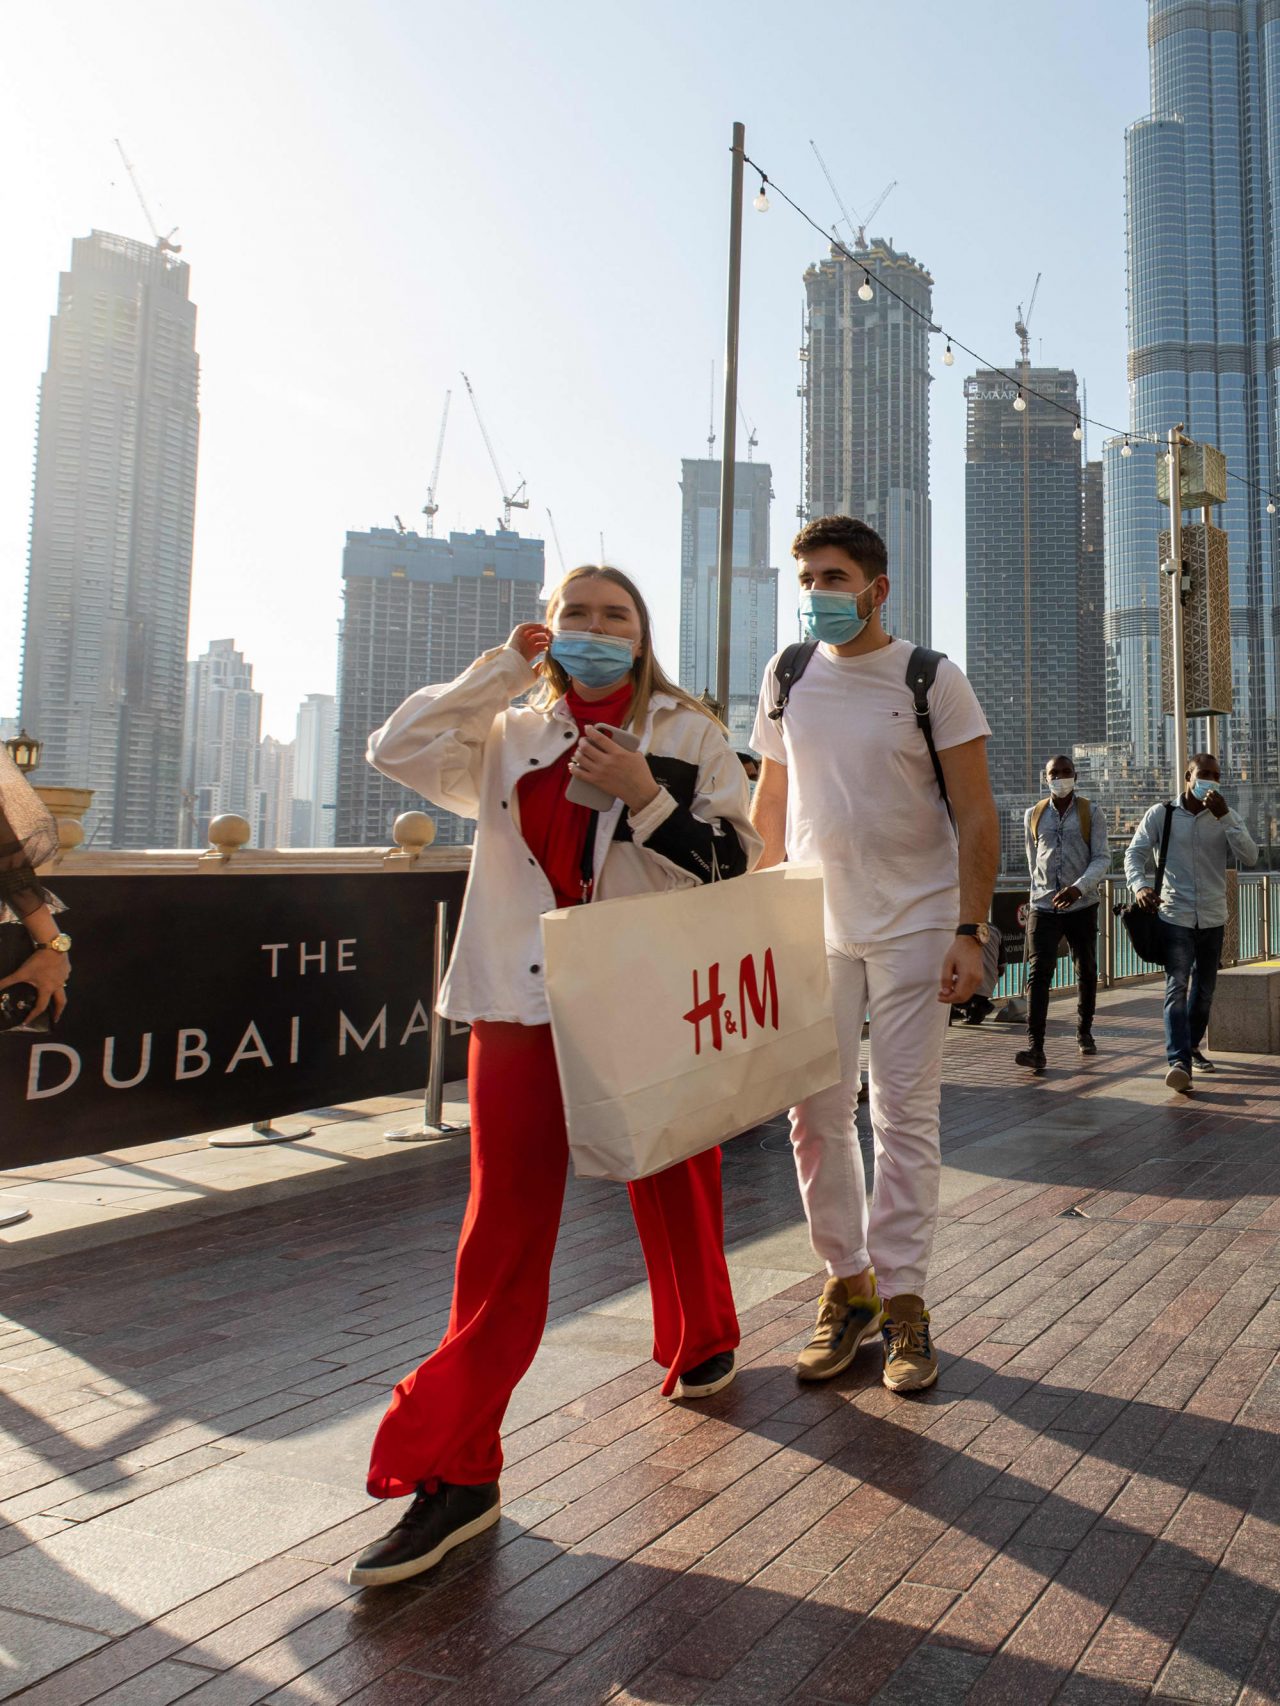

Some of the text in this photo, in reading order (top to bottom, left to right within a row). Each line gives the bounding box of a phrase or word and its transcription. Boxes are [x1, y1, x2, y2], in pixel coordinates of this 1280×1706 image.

[261, 939, 357, 978] THE
[683, 947, 780, 1055] H&M
[26, 1016, 300, 1101] DUBAI
